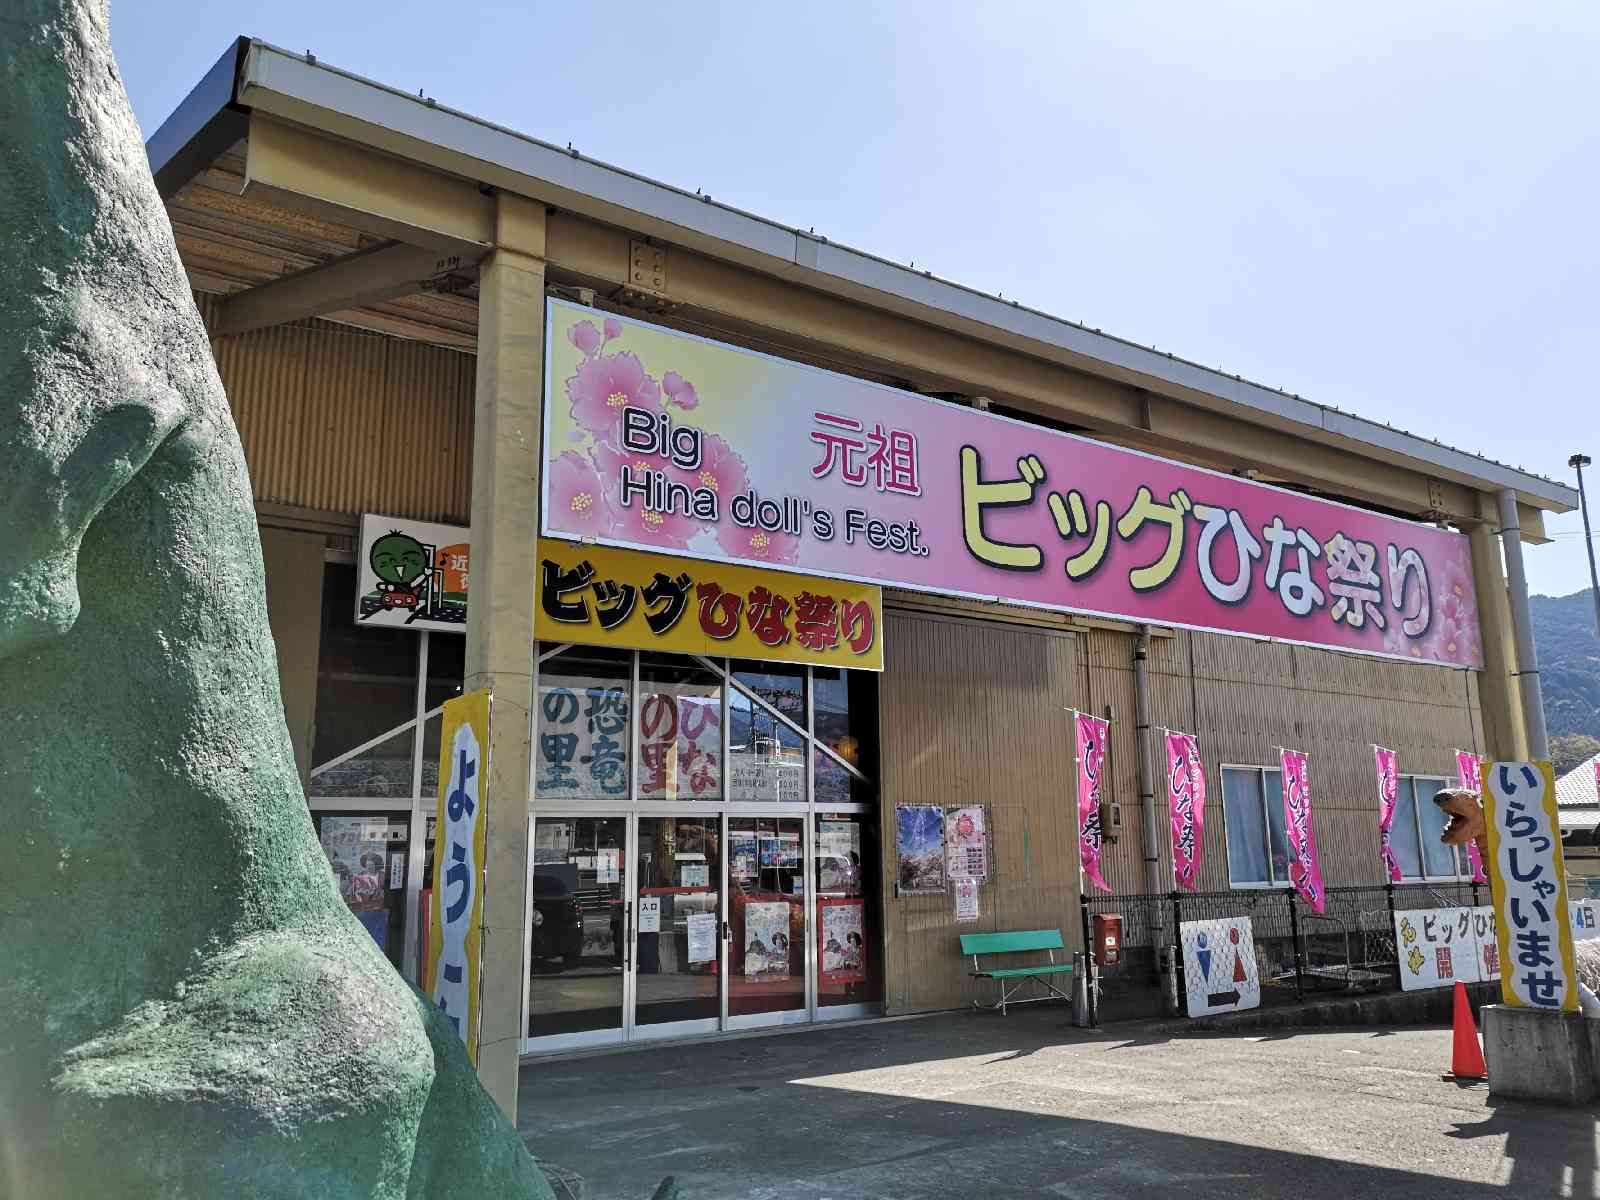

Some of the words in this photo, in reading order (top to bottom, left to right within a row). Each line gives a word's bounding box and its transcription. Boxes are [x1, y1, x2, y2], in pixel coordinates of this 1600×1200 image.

[622, 407, 703, 469] Big
[811, 412, 921, 496] 元祖
[620, 466, 718, 520] Hina
[730, 490, 834, 541] doll's
[844, 510, 929, 557] Fest.
[960, 444, 1432, 638] ビッグひな祭り
[541, 559, 874, 654] ビッグひな祭り
[537, 688, 580, 790] の里
[680, 694, 720, 794] ひな
[1500, 765, 1562, 1007] いらっしゃいませ
